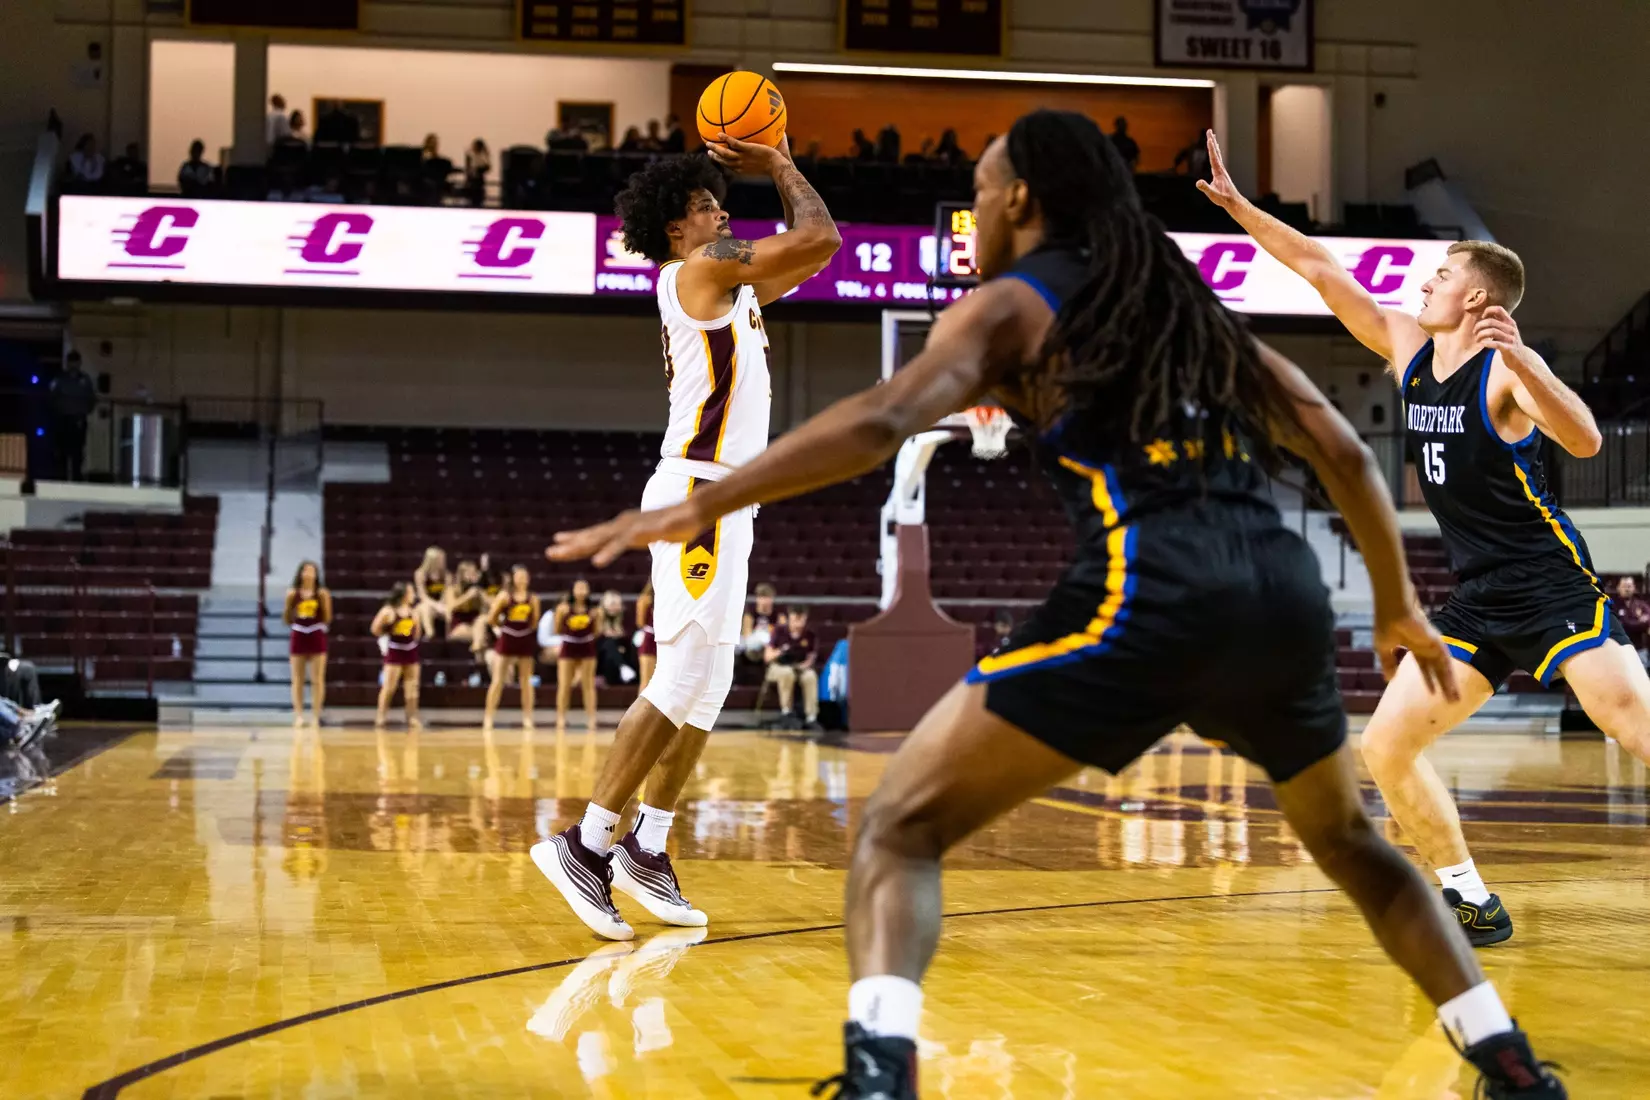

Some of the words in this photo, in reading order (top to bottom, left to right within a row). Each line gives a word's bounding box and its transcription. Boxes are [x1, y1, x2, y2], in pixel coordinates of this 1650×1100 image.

[1186, 36, 1252, 59] SWEET
[124, 206, 200, 257] C
[301, 213, 374, 263] C
[474, 218, 546, 267] C
[855, 242, 893, 272] 12
[1199, 242, 1257, 290] C
[1353, 246, 1415, 293] C
[1437, 405, 1466, 433] PARK
[1422, 442, 1446, 485] 15
